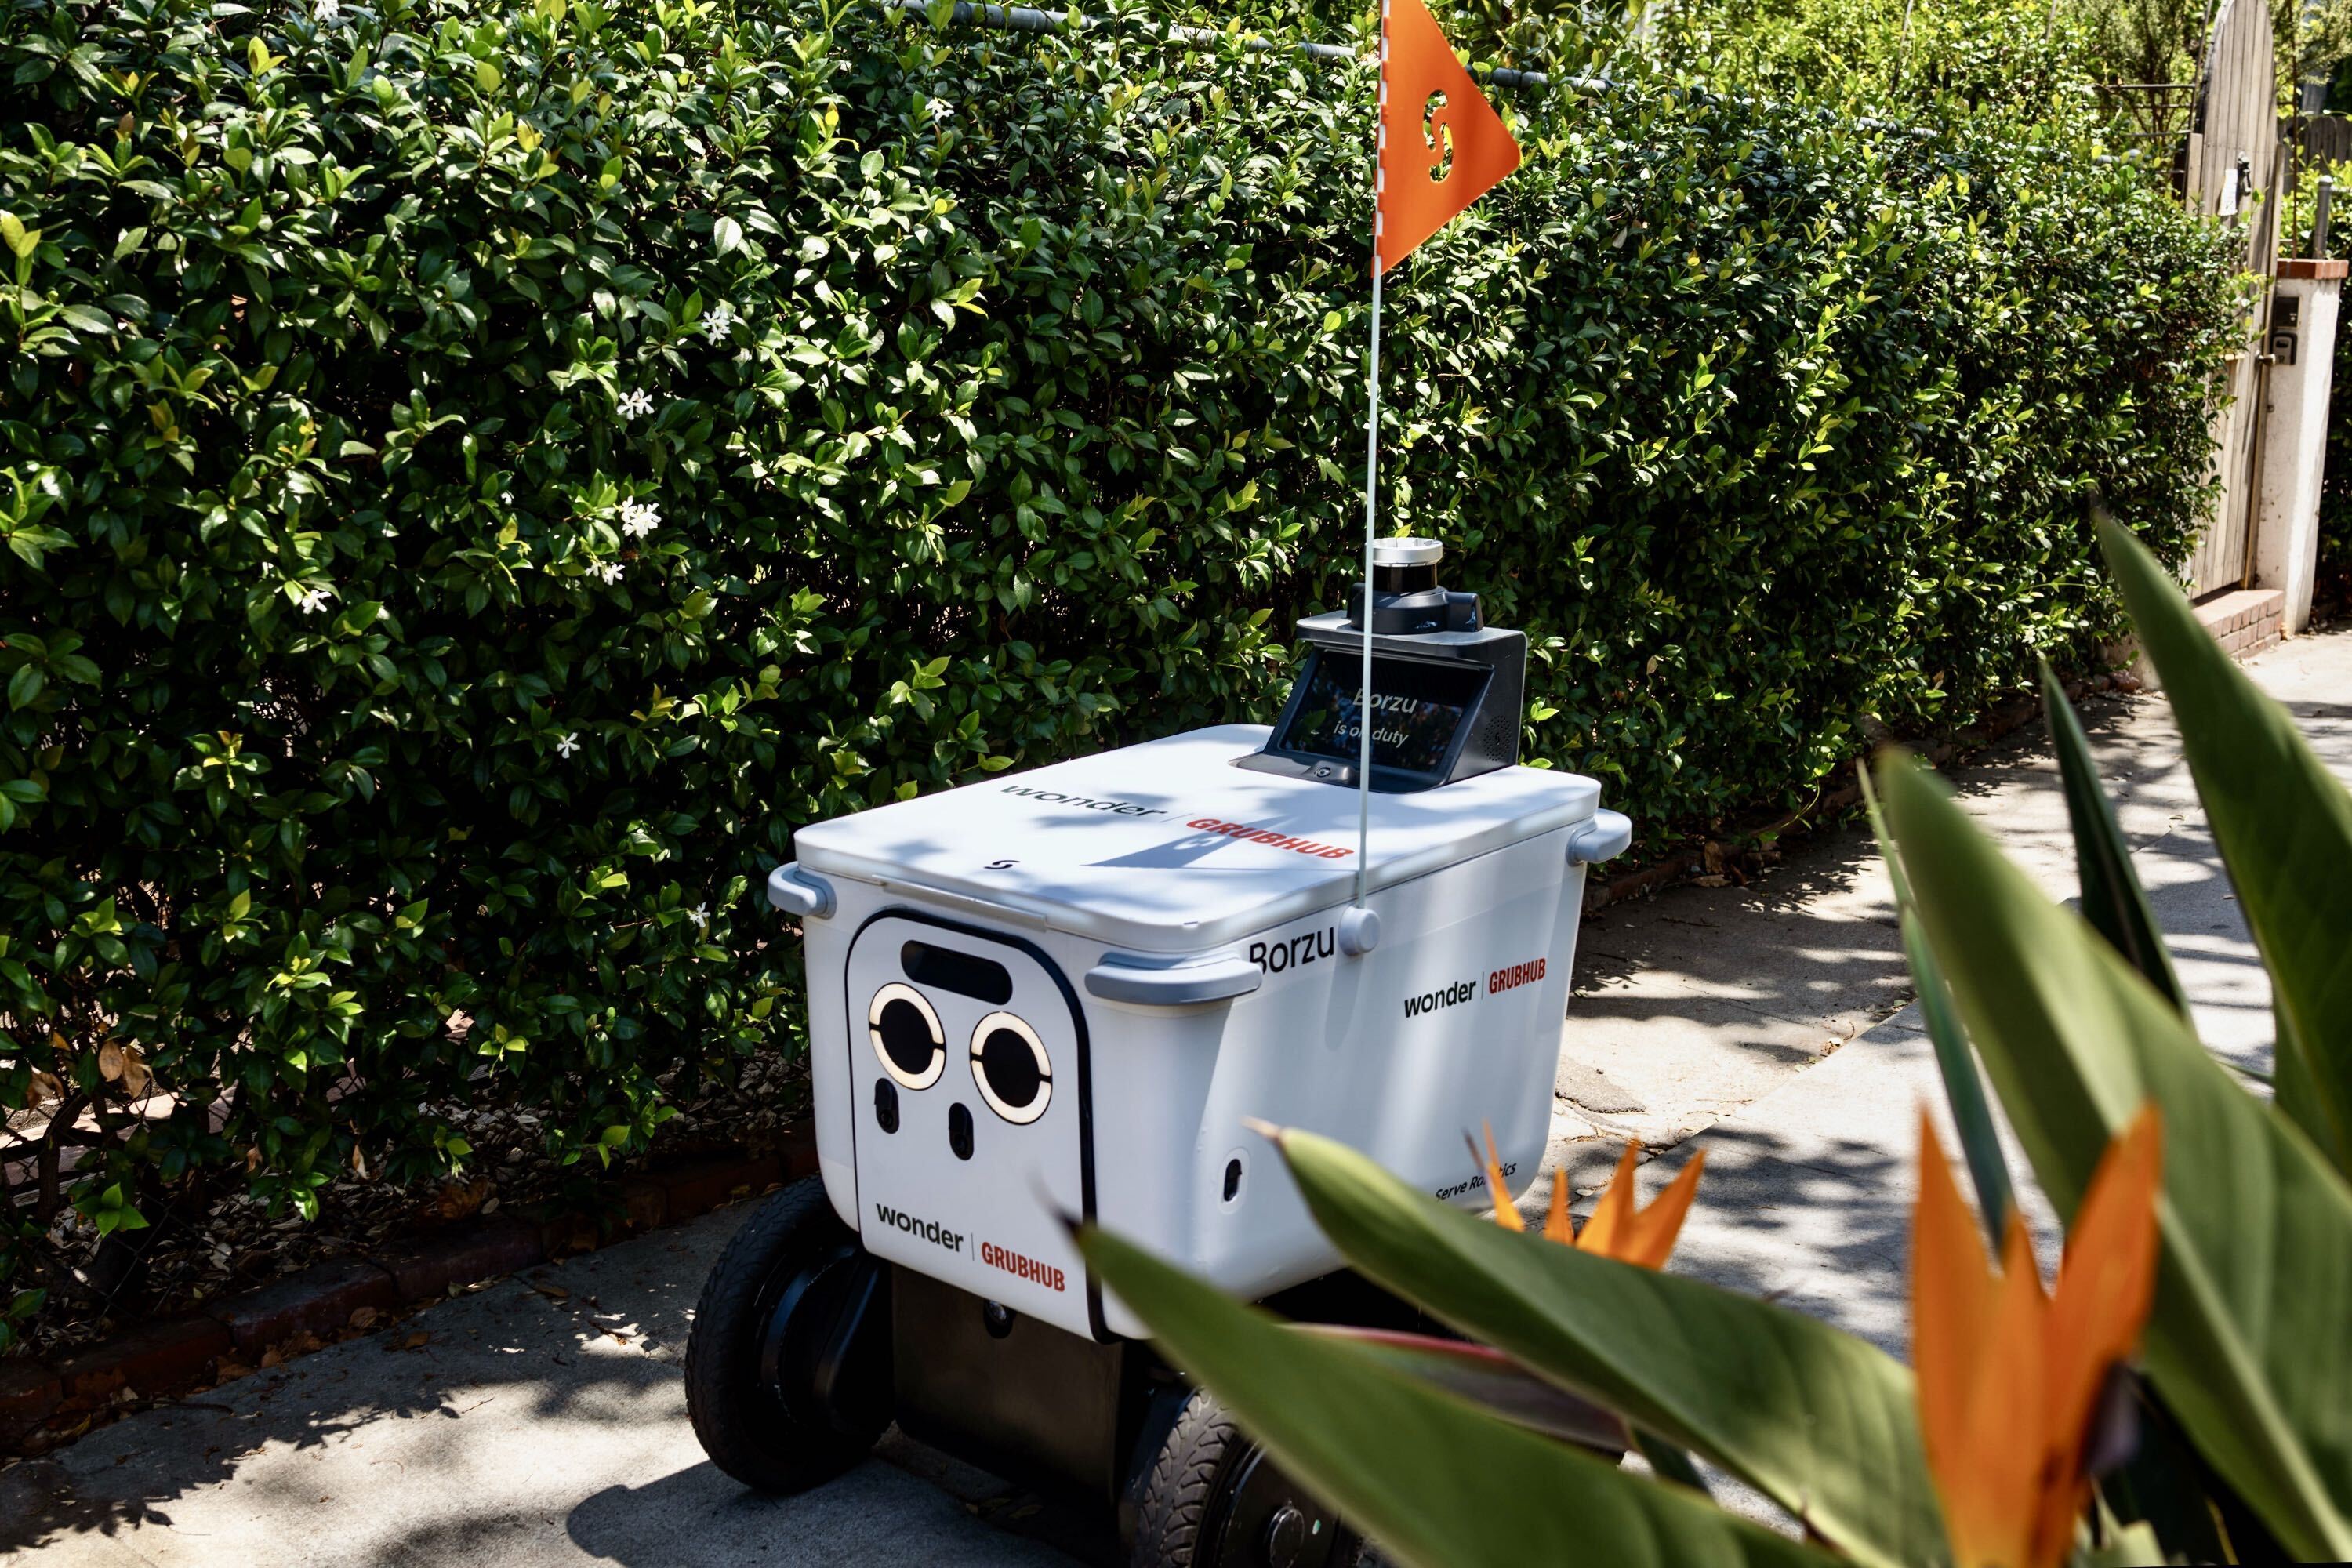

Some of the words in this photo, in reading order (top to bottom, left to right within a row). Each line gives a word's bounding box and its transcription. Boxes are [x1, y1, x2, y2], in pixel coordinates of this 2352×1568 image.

[1333, 720, 1347, 735] is
[1349, 726, 1365, 738] o
[1372, 728, 1410, 748] duty
[1001, 786, 1167, 817] wonder
[1186, 818, 1355, 858] GRUBHUB
[1250, 927, 1334, 975] Borzu
[1404, 979, 1476, 1018] wonder
[1489, 958, 1546, 994] GRUBHUB
[1436, 1181, 1467, 1202] Serve
[1469, 1162, 1517, 1190] Roics
[876, 1203, 964, 1252] wonder
[982, 1241, 1065, 1292] GRUBHUB
